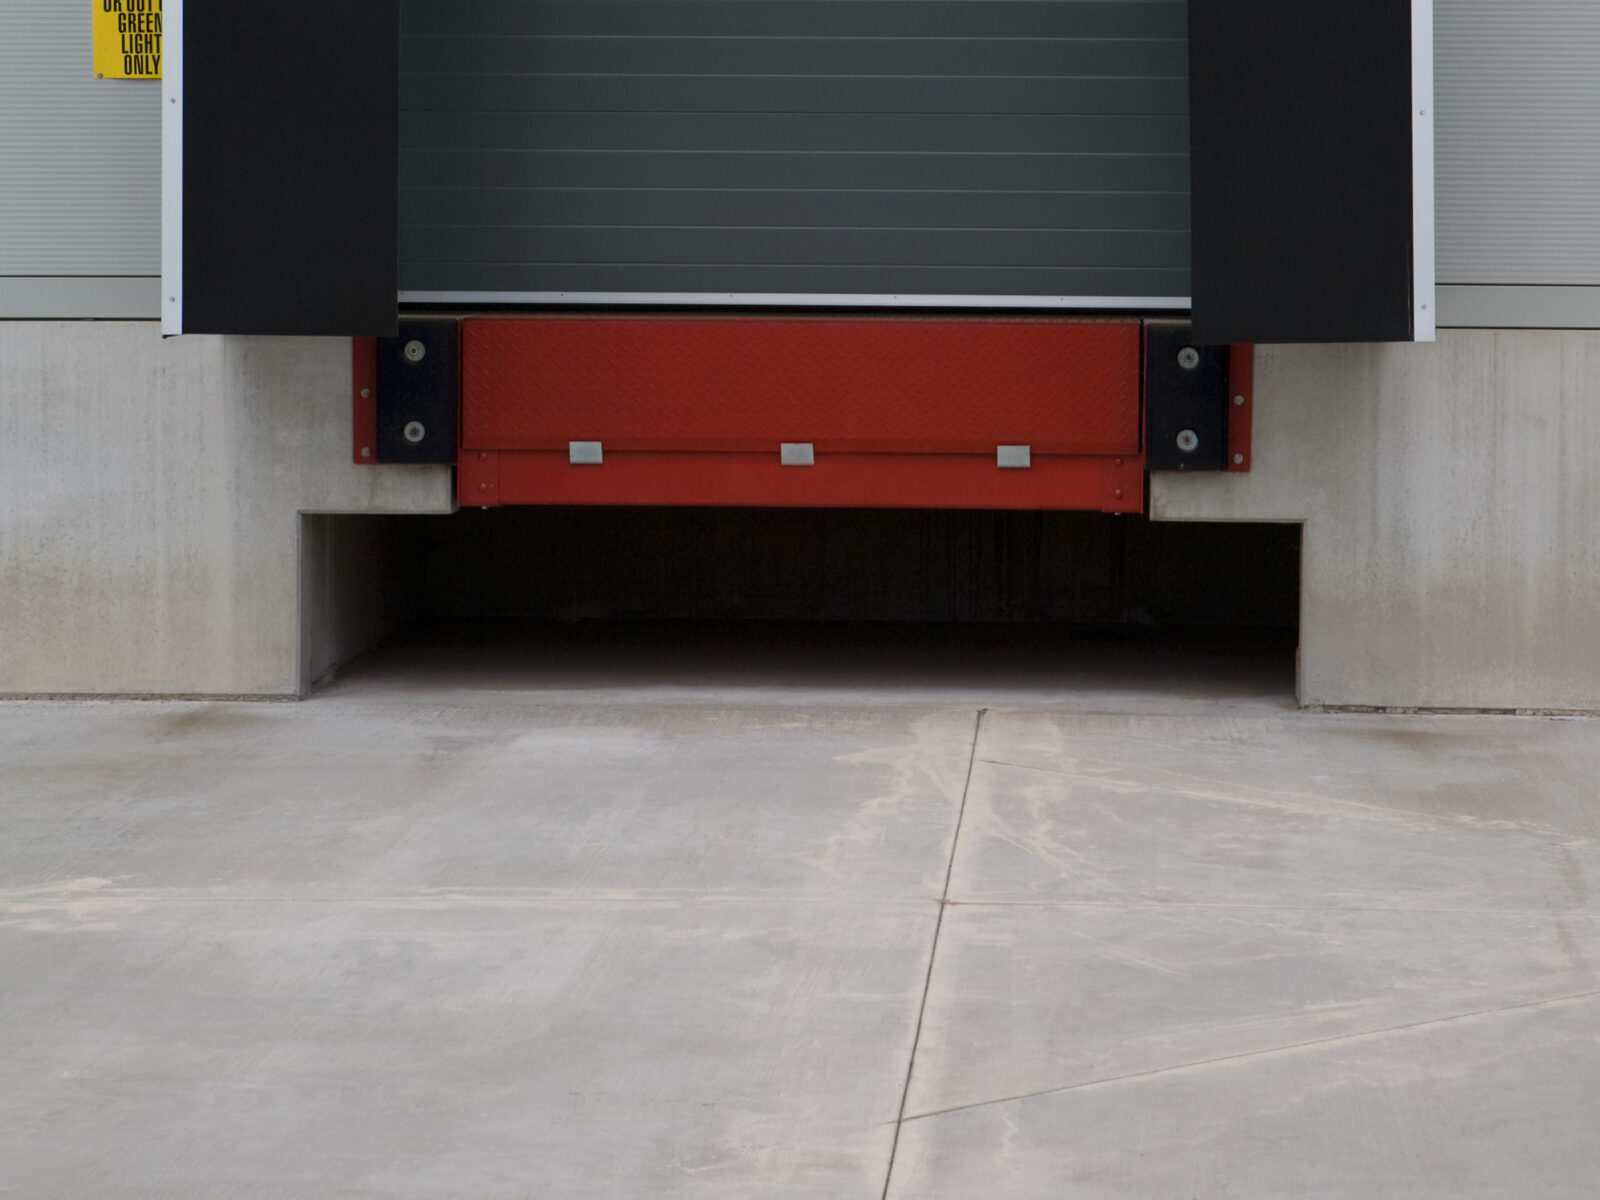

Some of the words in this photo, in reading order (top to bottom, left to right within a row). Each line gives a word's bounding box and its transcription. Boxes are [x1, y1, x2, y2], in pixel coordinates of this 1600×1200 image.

[118, 12, 162, 33] GREEN
[121, 33, 162, 54] LIGHT
[124, 54, 161, 75] ONLY
